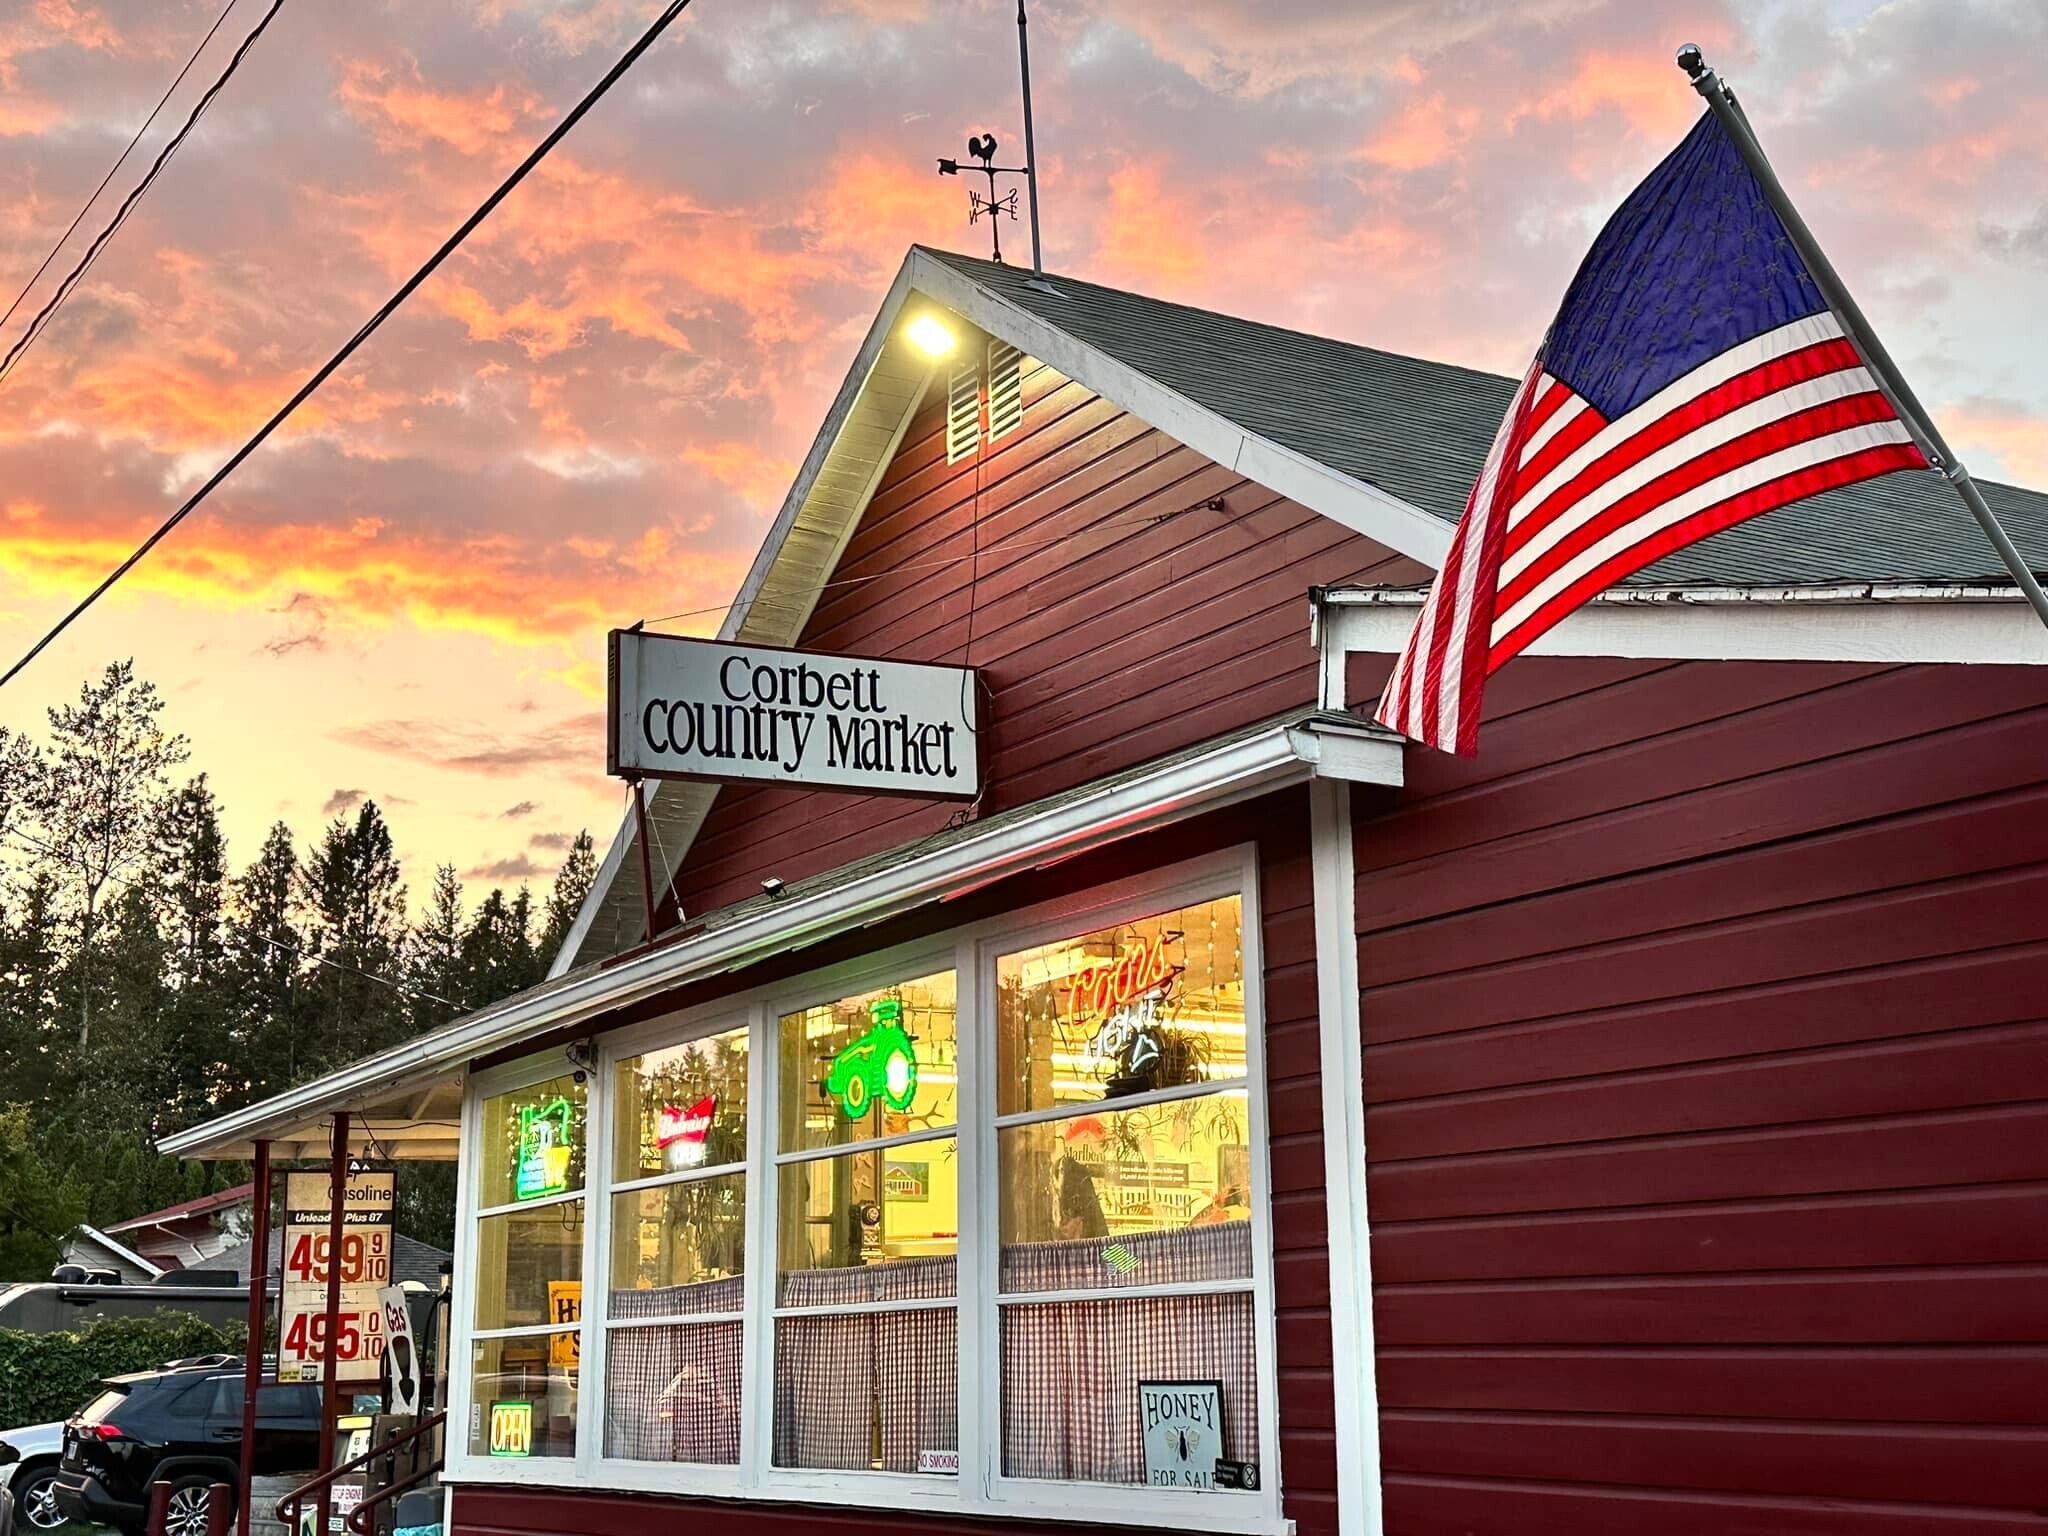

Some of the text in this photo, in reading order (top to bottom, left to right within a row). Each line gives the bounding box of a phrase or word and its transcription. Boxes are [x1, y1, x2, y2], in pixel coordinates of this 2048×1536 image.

[719, 655, 887, 713] Corbett
[827, 714, 957, 778] Market
[1066, 934, 1168, 1031] Coors
[295, 1212, 383, 1223] Unlead Plus 87
[289, 1233, 387, 1283] 499 9 10
[285, 1312, 382, 1361] 495 0 10
[385, 1301, 407, 1333] Gas
[492, 1408, 531, 1452] OPEN
[1145, 1392, 1215, 1432] HONEY
[1153, 1469, 1177, 1487] FOR
